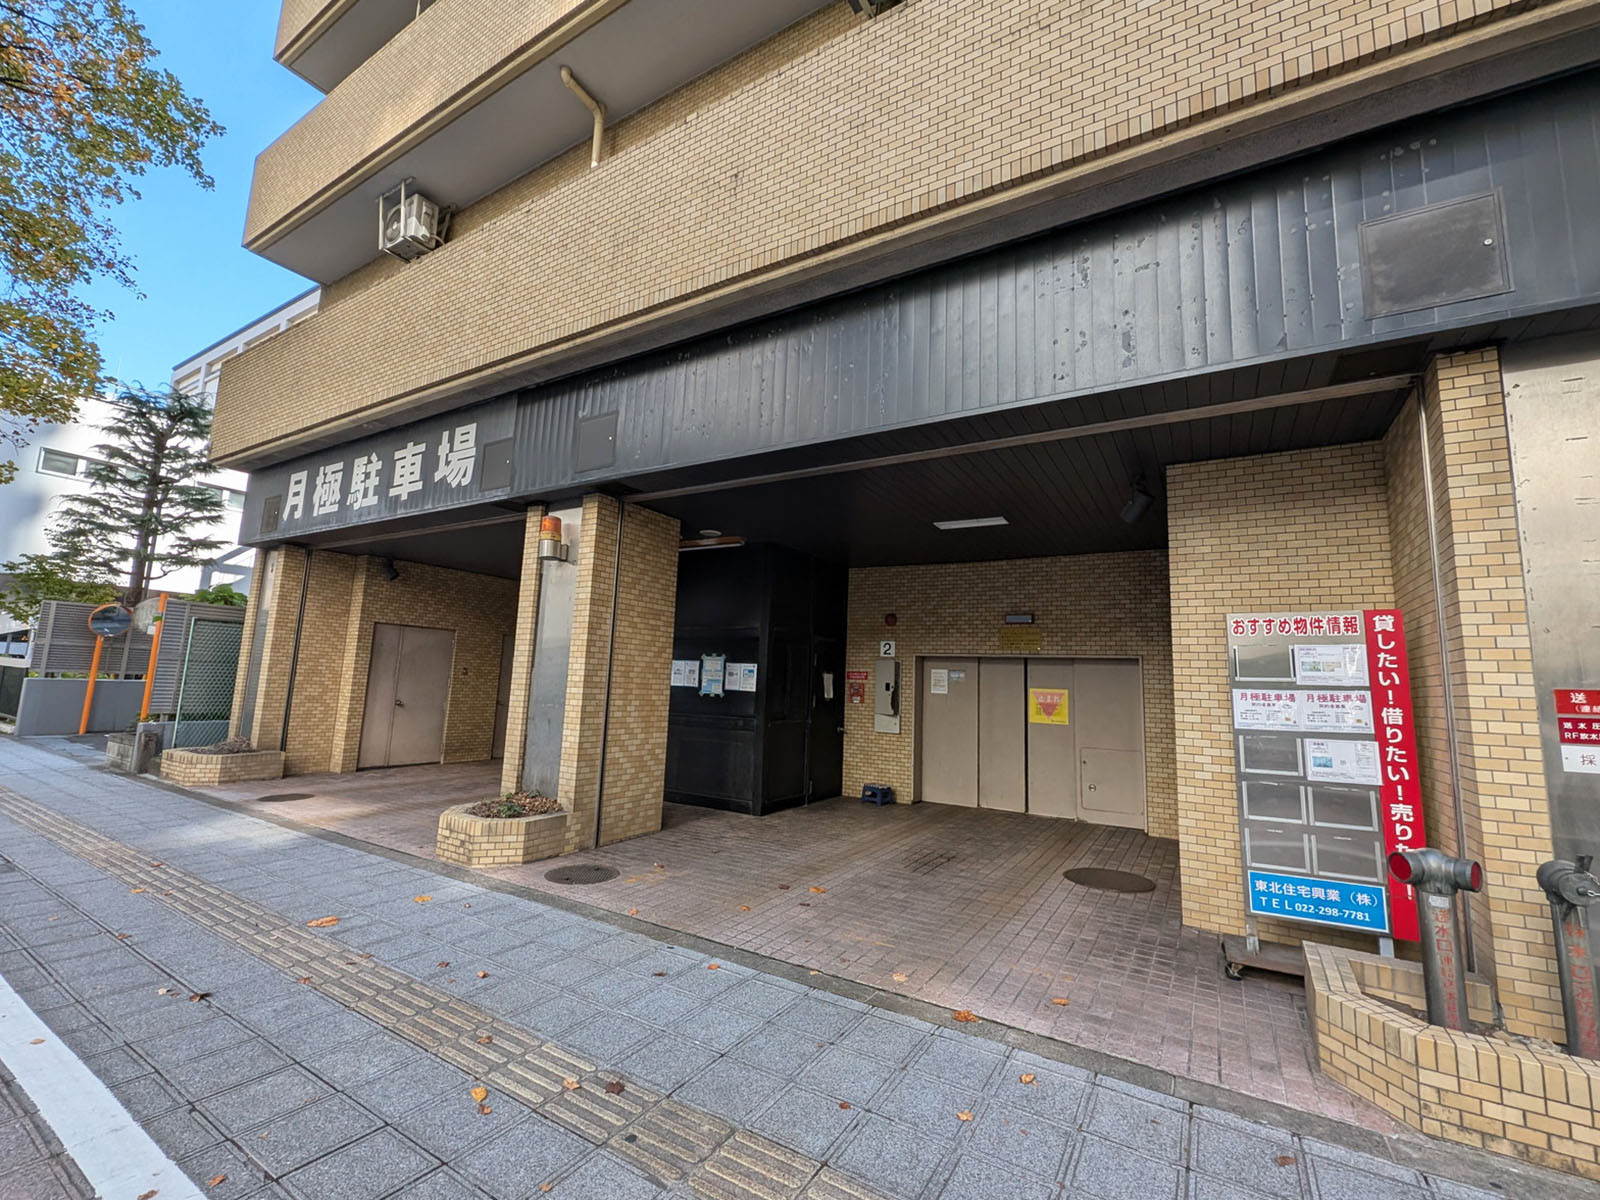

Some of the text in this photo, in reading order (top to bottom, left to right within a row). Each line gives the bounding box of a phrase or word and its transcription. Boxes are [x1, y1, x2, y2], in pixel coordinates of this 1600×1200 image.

[282, 422, 478, 521] 月極駐車場
[1232, 615, 1361, 637] おすすめ物件情報
[882, 642, 892, 656] 2
[1240, 692, 1296, 703] 月極駐車場
[1306, 693, 1367, 704] 月極駐車場
[1564, 732, 1600, 741] RF放水
[1371, 614, 1415, 901] 貸したい！借りたい！売り！
